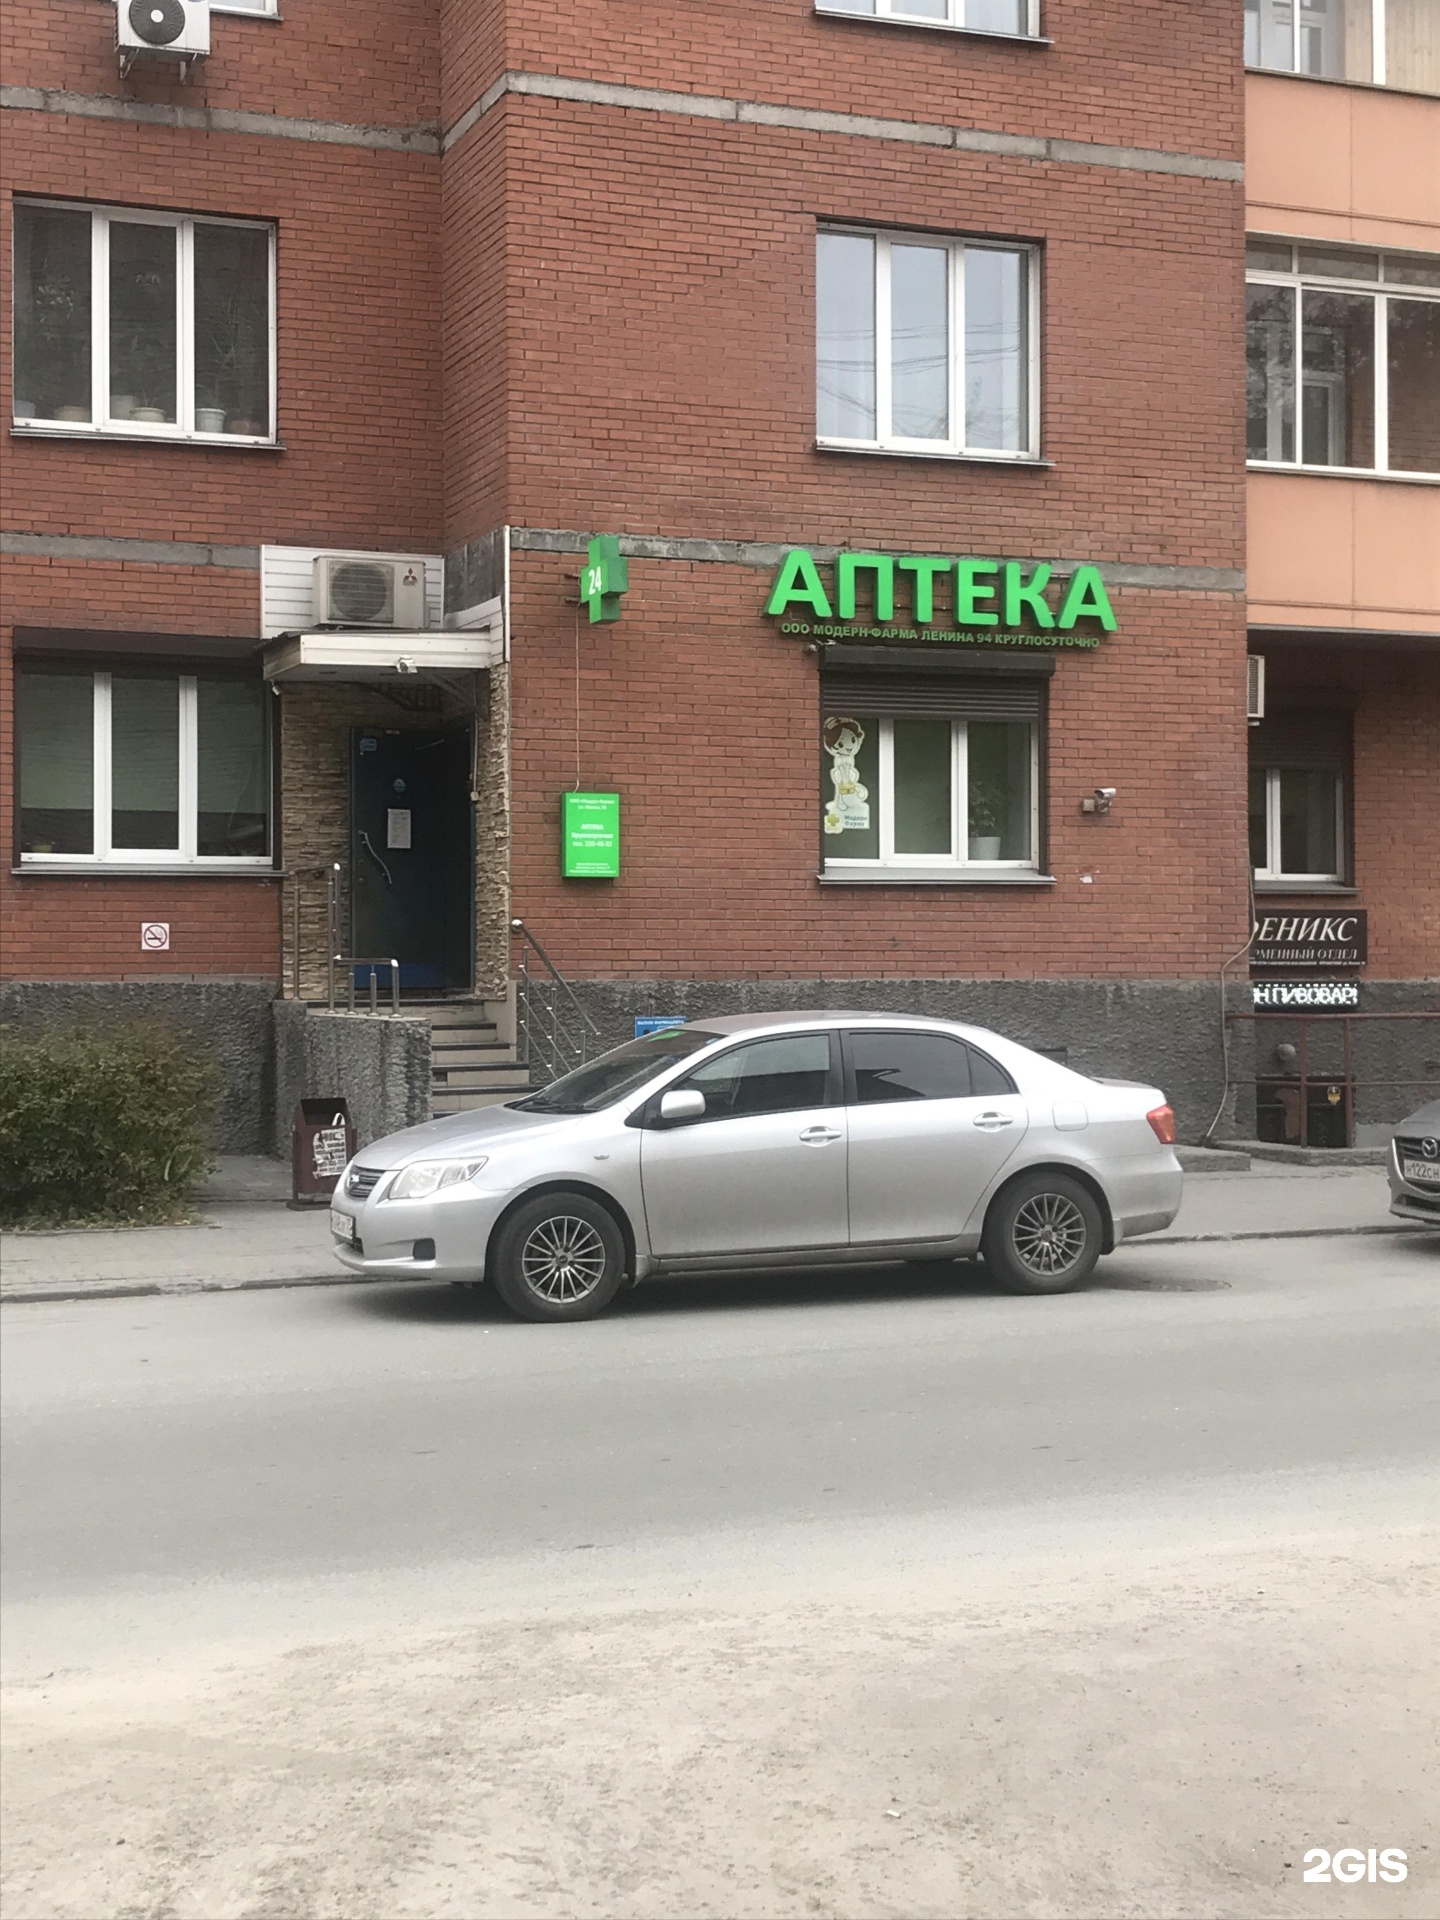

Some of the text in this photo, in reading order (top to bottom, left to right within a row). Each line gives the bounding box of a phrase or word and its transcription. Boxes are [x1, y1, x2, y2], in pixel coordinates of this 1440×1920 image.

[588, 565, 602, 596] 24
[765, 549, 1118, 632] АПТЕКА
[781, 622, 1101, 648] ООО МОДЕРН-ФАРМА ЛЕНИНА 94 КРУГЛОСУТОЧНО
[1317, 948, 1359, 960] ОТДЕЛ
